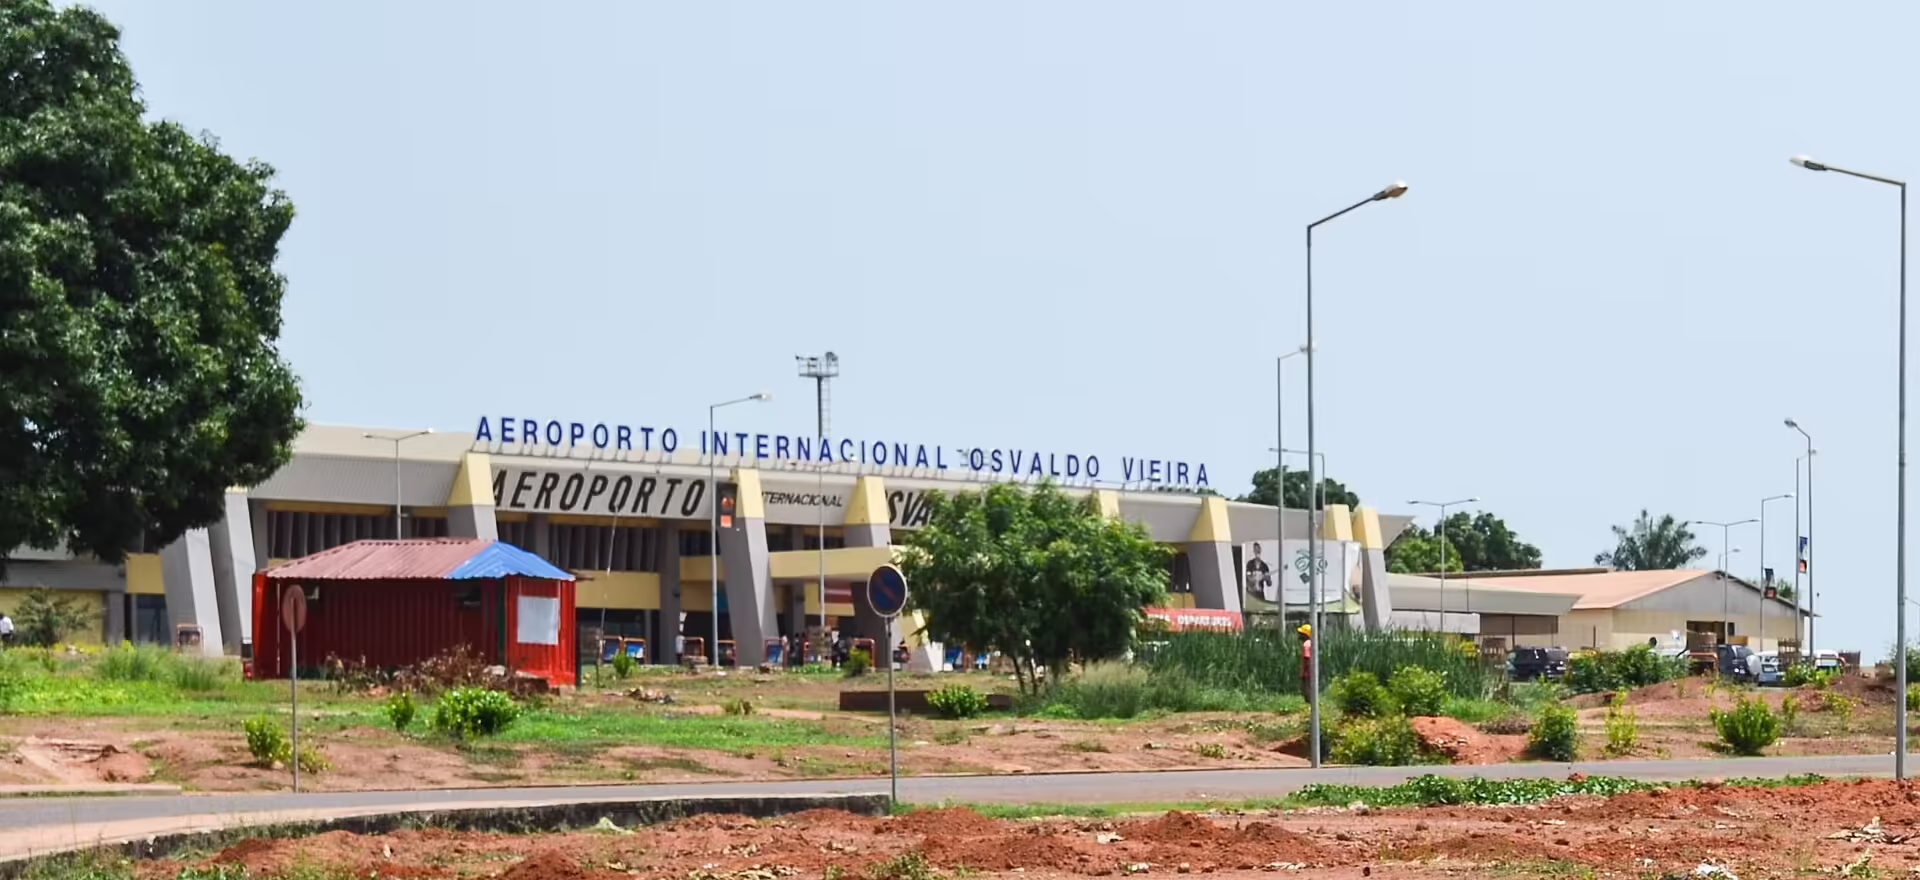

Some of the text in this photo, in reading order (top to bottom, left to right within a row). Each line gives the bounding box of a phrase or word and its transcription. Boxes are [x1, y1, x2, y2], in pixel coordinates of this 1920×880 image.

[476, 416, 1208, 486] AEROPORTO INTERNACIONAL OSVALDO VIEIRA
[494, 470, 706, 517] AEROPORTO
